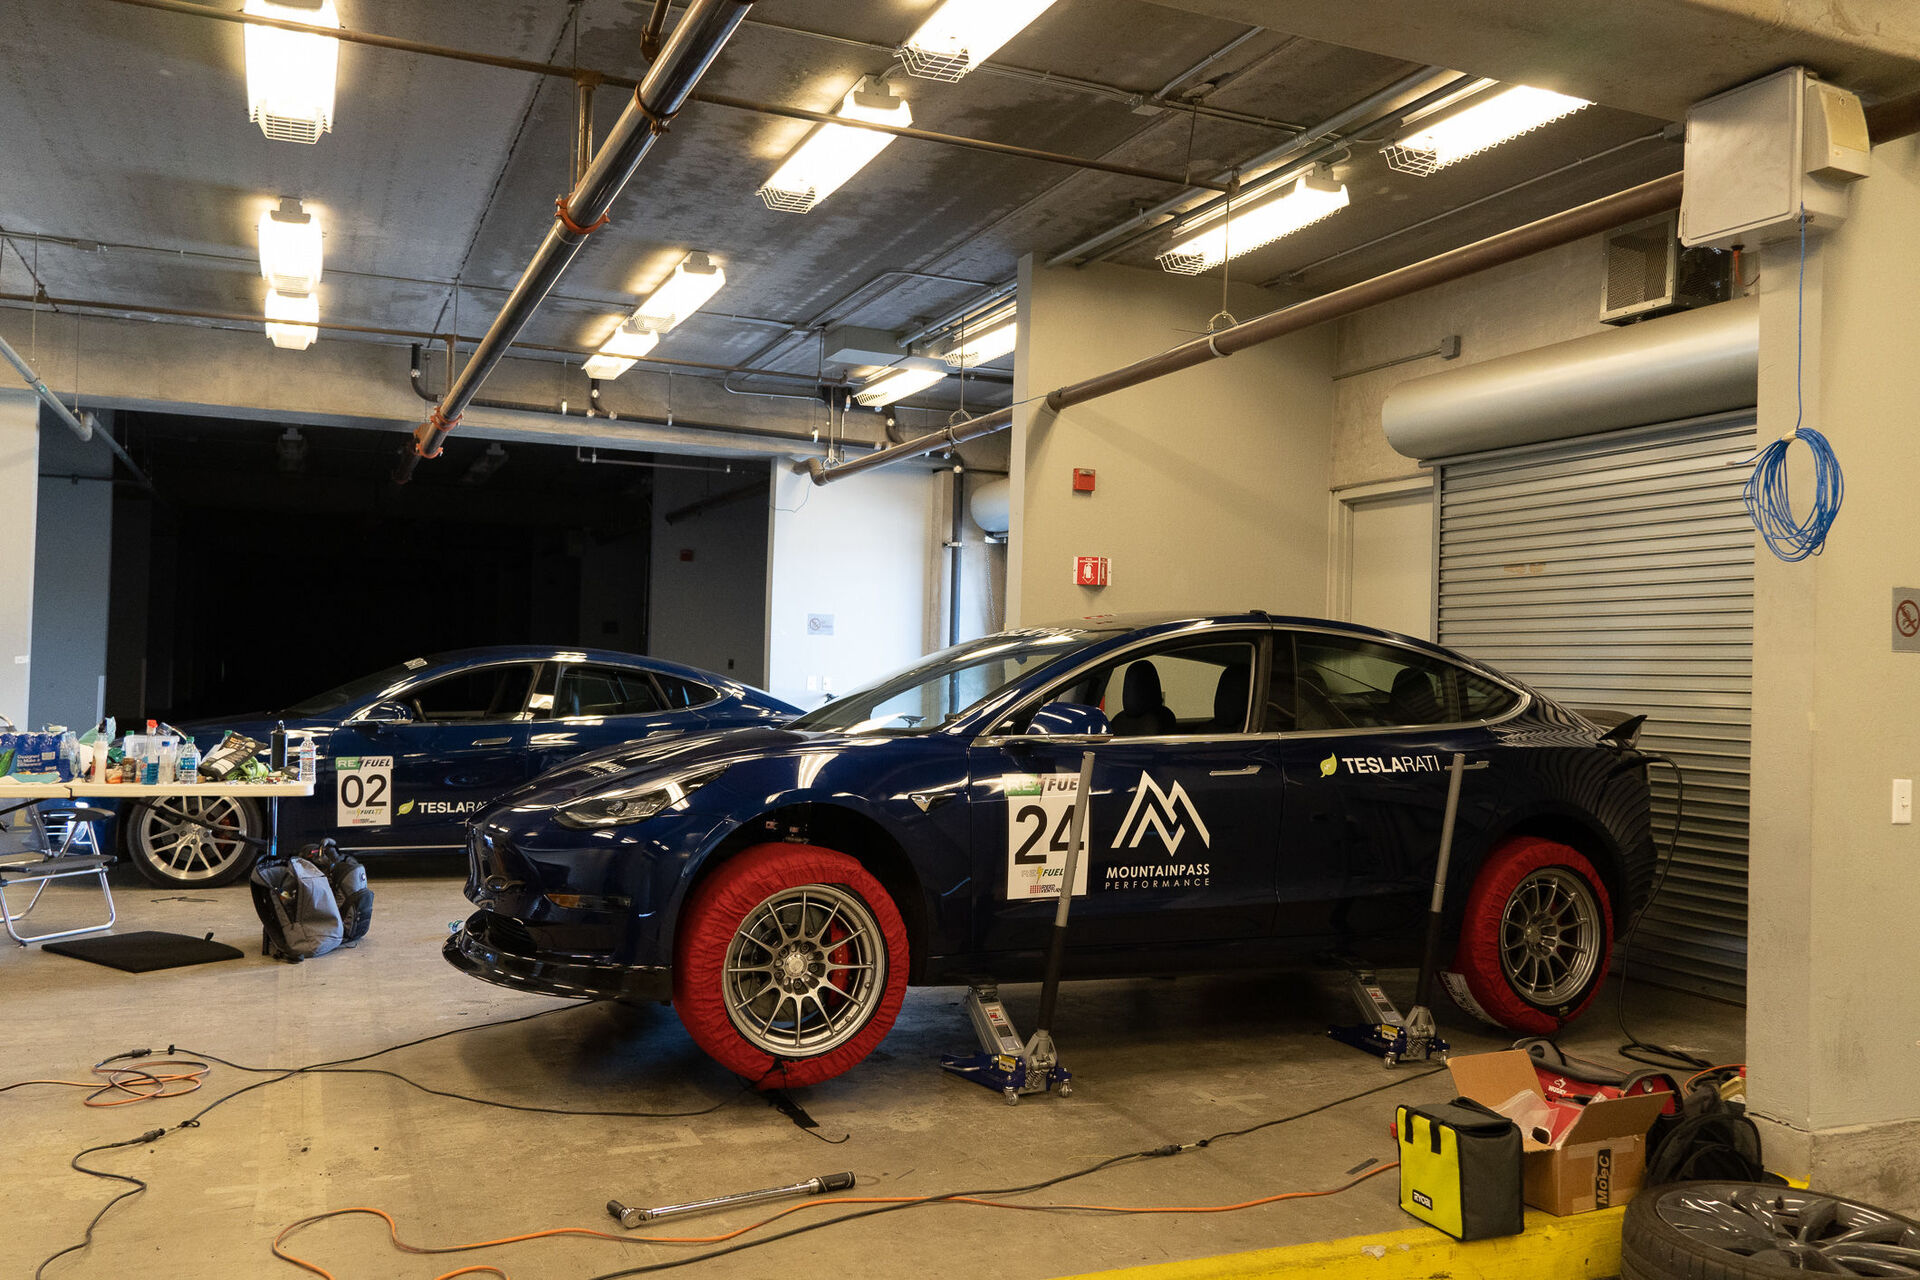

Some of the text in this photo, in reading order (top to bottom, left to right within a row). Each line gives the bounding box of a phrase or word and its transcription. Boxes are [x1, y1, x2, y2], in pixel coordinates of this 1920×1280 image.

[364, 758, 391, 768] FUEL
[1341, 755, 1440, 774] TESLARATI
[341, 774, 387, 809] 02
[1047, 777, 1079, 791] FUE
[1014, 804, 1085, 866] 24
[1106, 863, 1210, 879] MOUNTAINPASS
[1104, 878, 1210, 890] PERFORMANCE
